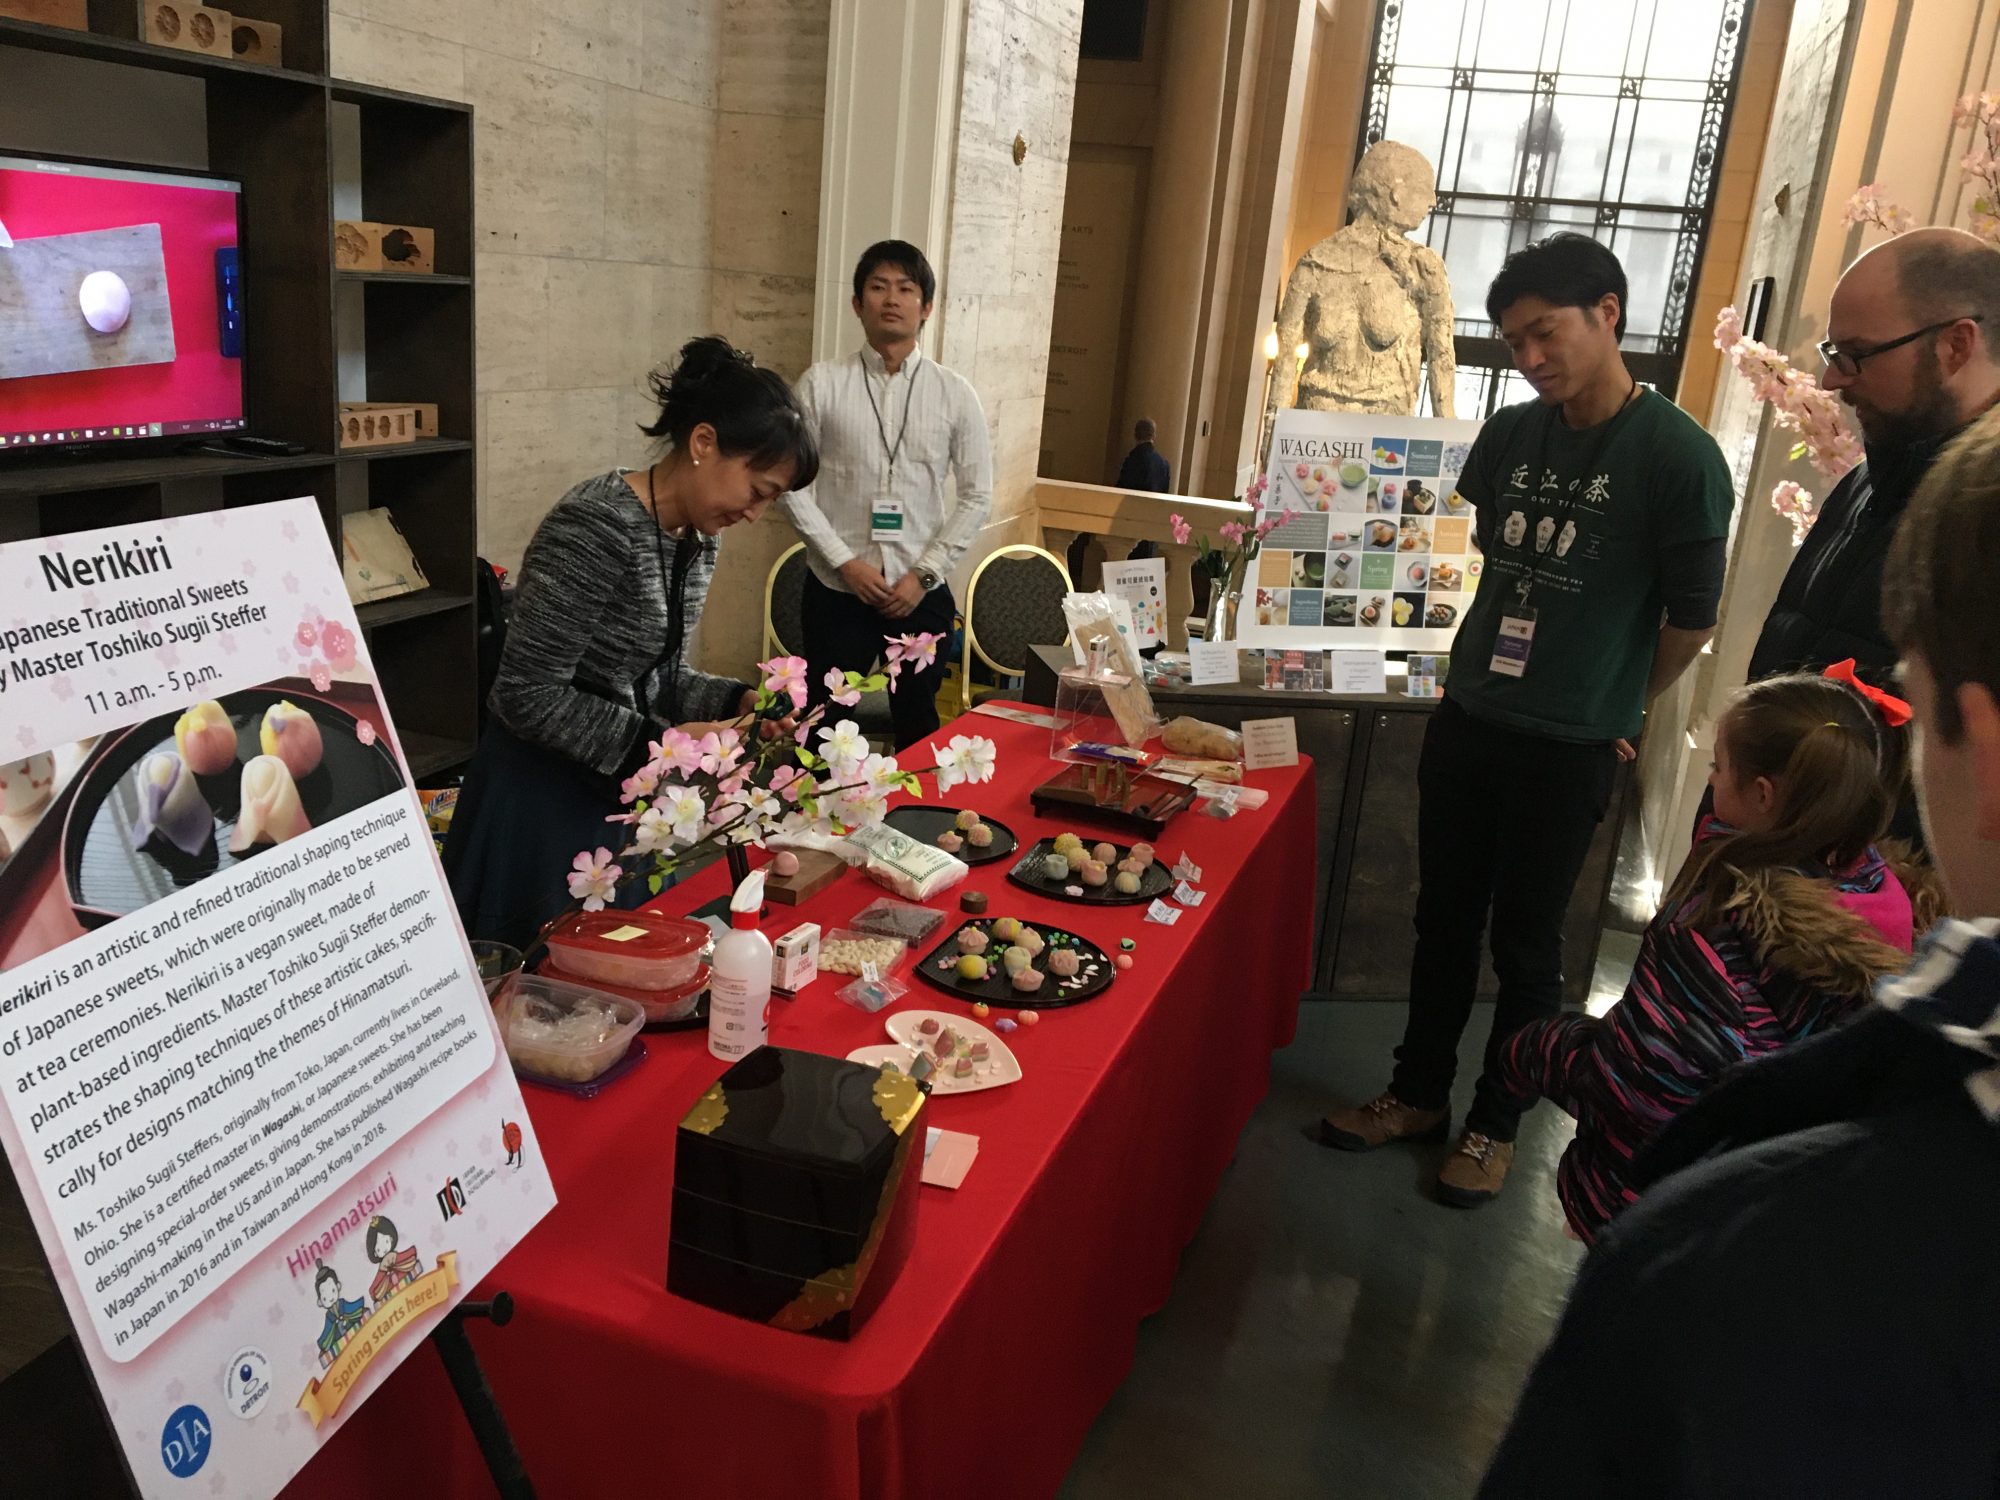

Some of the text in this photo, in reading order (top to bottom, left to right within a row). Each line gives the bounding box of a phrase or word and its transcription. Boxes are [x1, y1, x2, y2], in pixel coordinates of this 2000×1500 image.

[1280, 438, 1365, 460] WAGASHI
[0, 579, 249, 654] panese Traditional Sweets
[10, 649, 84, 683] Master
[85, 629, 164, 663] Toshiko
[164, 614, 211, 644] Sugii
[210, 603, 267, 632] Steffer
[38, 535, 173, 593] Nerikiri
[84, 690, 110, 715] 11
[114, 684, 156, 708] a.m.
[167, 670, 181, 692] 5
[182, 665, 223, 693] p.m.
[0, 807, 407, 1018] erikiri is an artistic and refined traditional shaping technique
[2, 832, 411, 1057] of Japanese sweets, which were originally made to be served
[16, 880, 376, 1094] at tea ceremonies. Nerikiri is a vegan sweet, made of
[29, 889, 431, 1134] plant-based ingredients. Master Toshiko Sugii Steffer demon-
[43, 912, 438, 1165] strates the shaping techniques of these artistic cakes, specifi-
[57, 959, 413, 1199] cally for designs matching the themes of Hinamatsuri.
[73, 967, 461, 1242] Ms. Toshiko Sugii Steffers, originally from Toko, Japan, currently lives in Cleveland,
[83, 1005, 443, 1267] Ohio. She is a certified master in Wagashi, or Japanese sweets. She has been
[95, 1013, 466, 1294] designing special-order sweets, giving demonstrations, exhibiting and teaching
[103, 1029, 478, 1320] Wagashi-making in the US and in Japan. She has published Wagashi recipe books
[113, 1121, 388, 1347] in Japan in 2016 and in Taiwan and Hong Kong in 2018.
[286, 1171, 397, 1278] Hinamatsuri
[240, 1382, 270, 1414] DETROIT
[332, 1281, 438, 1393] Spring starts here!
[164, 1417, 211, 1470] DIA
